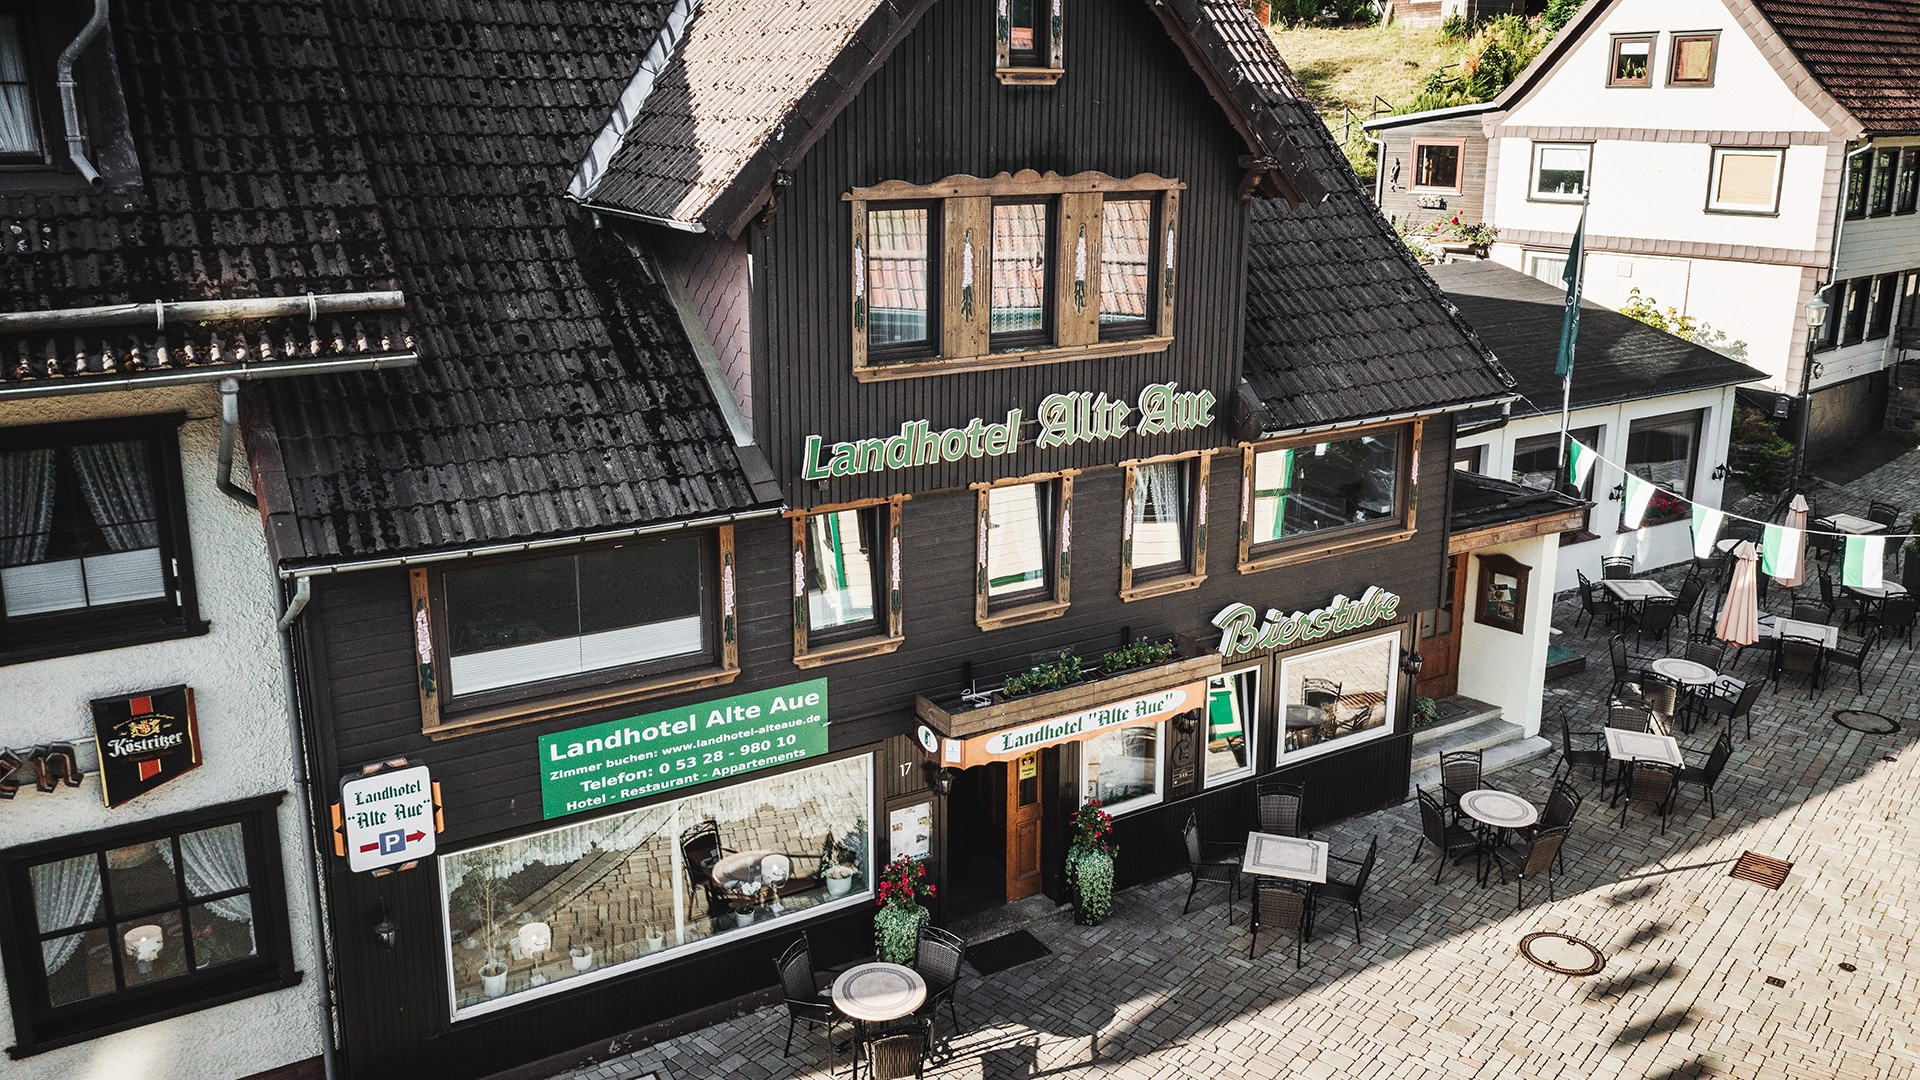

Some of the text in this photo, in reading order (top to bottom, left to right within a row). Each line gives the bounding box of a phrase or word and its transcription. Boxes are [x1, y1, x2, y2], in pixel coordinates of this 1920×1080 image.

[802, 381, 1216, 480] Landhotel Alte Aue
[1212, 586, 1400, 657] Bierstube
[107, 732, 183, 757] Köstritzer
[550, 692, 820, 762] Landhotel Alte Aue
[550, 714, 821, 781] Zimmer buchen: www.landhotel-alteaue.de
[1001, 693, 1173, 751] Landhotel "Alte Aue"
[566, 794, 606, 812] Hotel
[620, 772, 699, 798] Restaurant
[711, 749, 806, 777] Appartements
[580, 768, 653, 792] Telefon:
[659, 762, 671, 774] 0
[675, 756, 697, 771] 53
[703, 750, 723, 765] 28
[740, 740, 771, 756] 980
[776, 734, 796, 748] 10
[900, 761, 913, 777] 17
[354, 780, 422, 806] Landhotel
[385, 833, 400, 852] P
